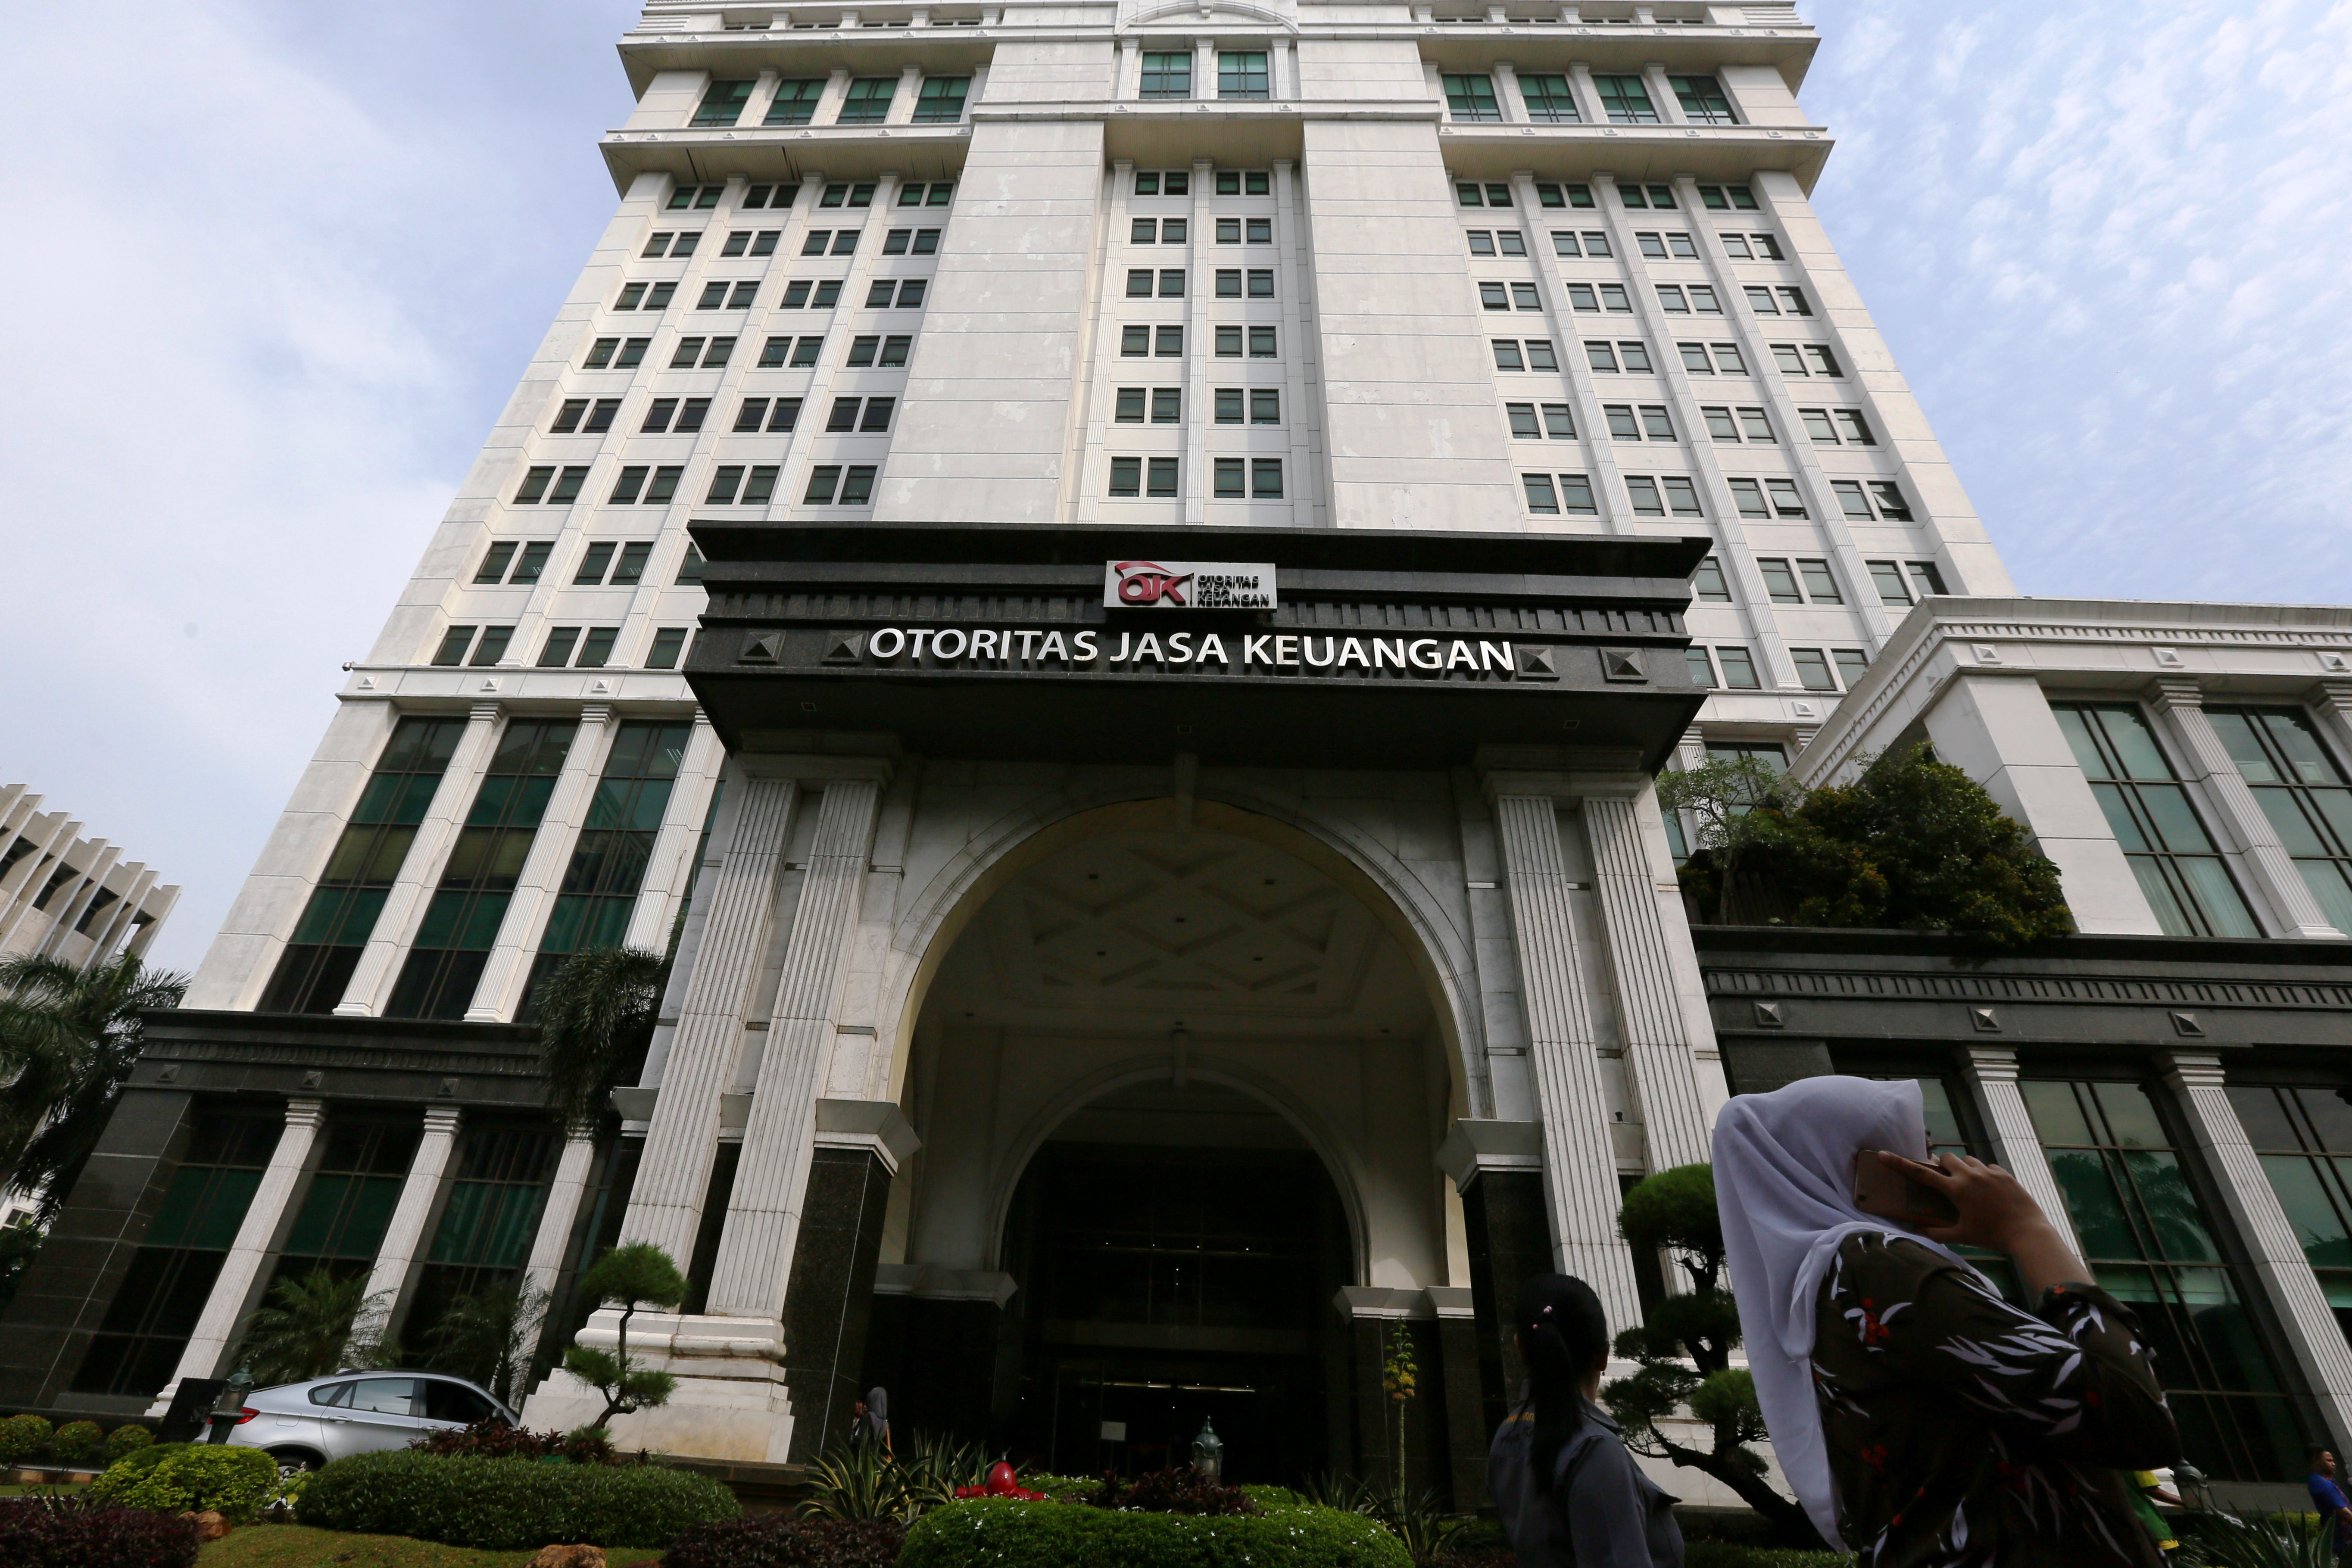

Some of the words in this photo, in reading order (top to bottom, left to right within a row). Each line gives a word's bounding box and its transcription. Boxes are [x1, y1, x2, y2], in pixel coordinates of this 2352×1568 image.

[1198, 574, 1259, 583] OTORITAS
[1117, 572, 1186, 605] OJK
[1198, 584, 1230, 592] JASA
[1197, 593, 1269, 602] KEUANGAN
[869, 627, 1099, 662] OTORITAS
[1109, 632, 1229, 664] JASA
[1243, 634, 1515, 671] KEUANGAN
